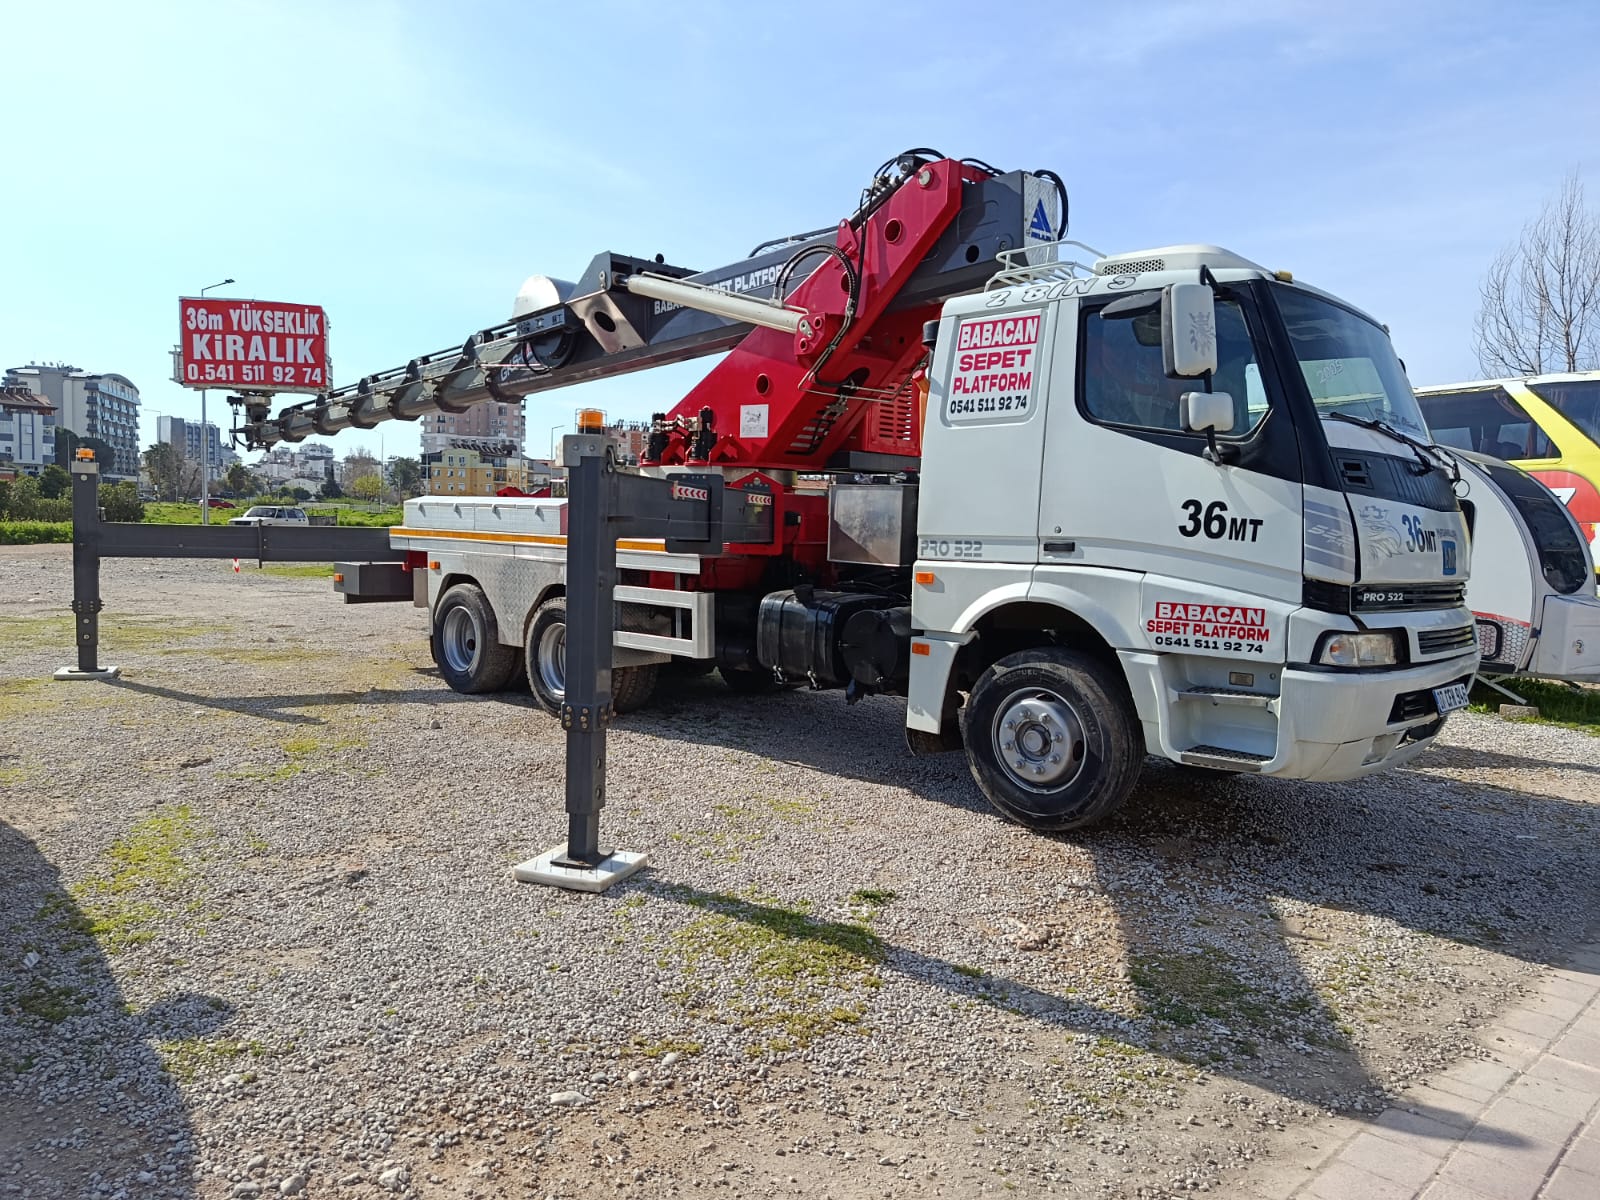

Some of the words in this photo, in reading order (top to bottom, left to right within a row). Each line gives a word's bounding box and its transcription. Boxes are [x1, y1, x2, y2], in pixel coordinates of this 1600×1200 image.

[186, 307, 223, 330] 36m
[229, 304, 320, 335] YÜKSEKLİK
[960, 317, 1039, 349] BABACAN
[959, 349, 1031, 372] SEPET
[187, 363, 234, 381] 0.541
[242, 364, 264, 381] 511
[273, 366, 295, 383] 92
[302, 367, 322, 384] 74
[953, 371, 1031, 394] PLATFORM
[950, 398, 975, 414] 0541
[977, 397, 995, 412] 511
[998, 396, 1012, 410] 92
[1015, 395, 1027, 409] 74
[920, 540, 949, 557] PRO
[954, 540, 983, 557] 522
[1363, 592, 1385, 602] PRO
[1387, 592, 1404, 601] 522
[1158, 603, 1263, 627] BABACAN
[1147, 620, 1189, 635] SEPET
[1193, 622, 1270, 642] PLATFORM
[1155, 636, 1189, 647] 0541
[1194, 639, 1219, 649] 511
[1223, 641, 1242, 652] 92
[1248, 643, 1263, 654] 74
